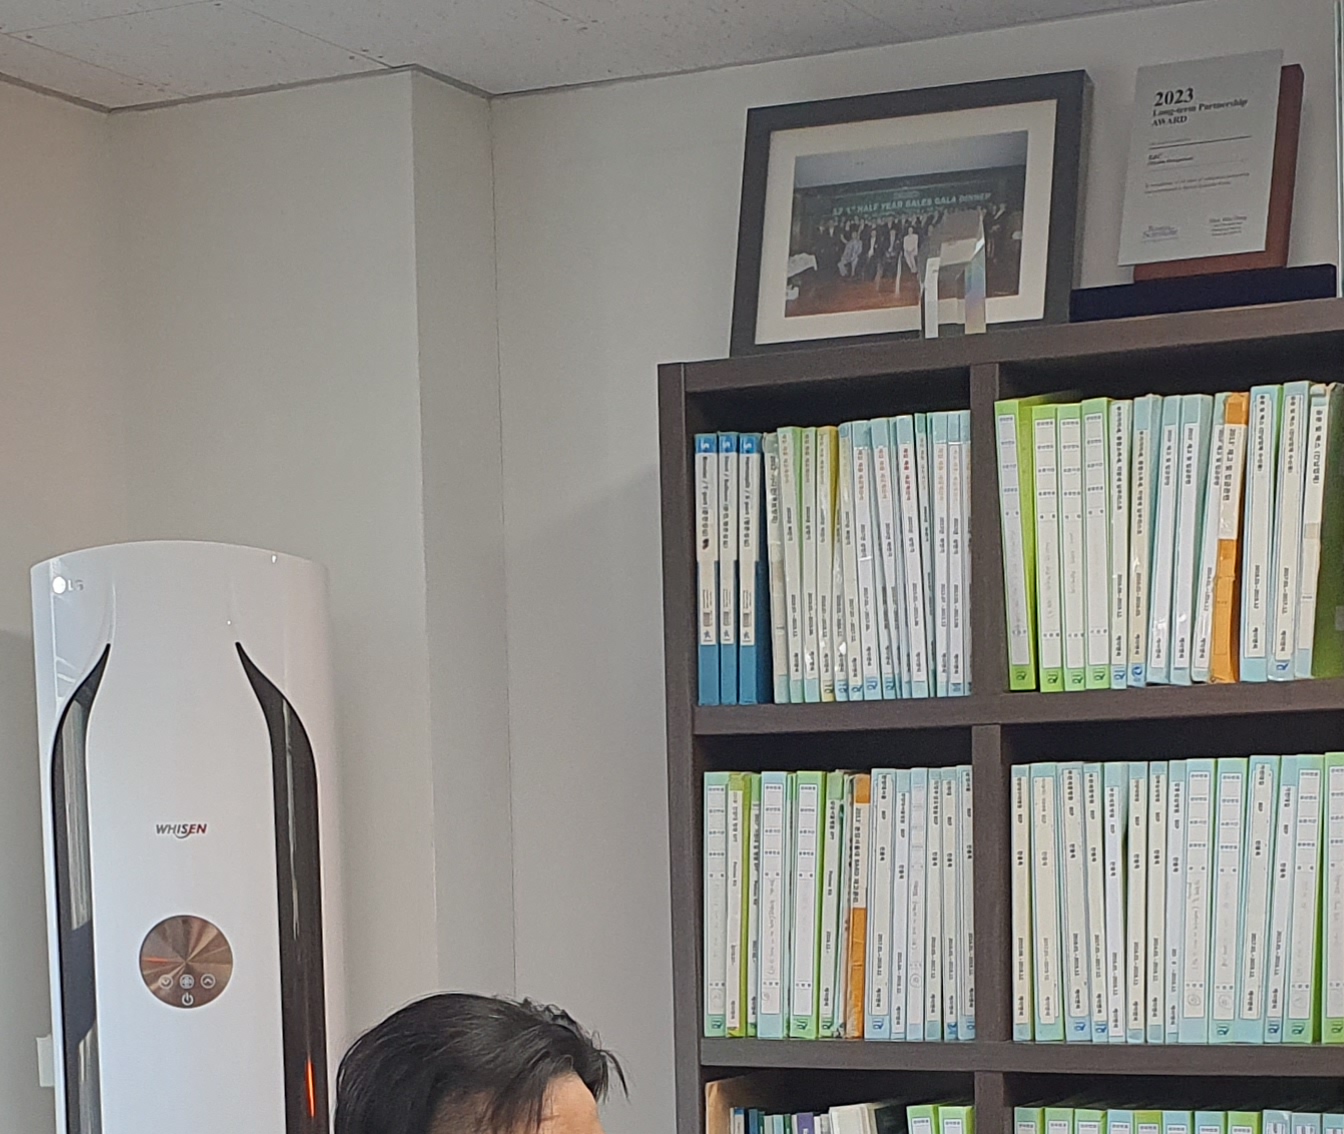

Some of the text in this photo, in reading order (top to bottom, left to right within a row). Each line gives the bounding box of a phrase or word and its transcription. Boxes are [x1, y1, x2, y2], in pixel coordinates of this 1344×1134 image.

[1154, 87, 1194, 107] 2023
[1152, 98, 1249, 118] Long-term Partnership
[1151, 115, 1188, 127] AWARD
[881, 200, 903, 211] YEAR
[156, 823, 207, 839] WHISEN
